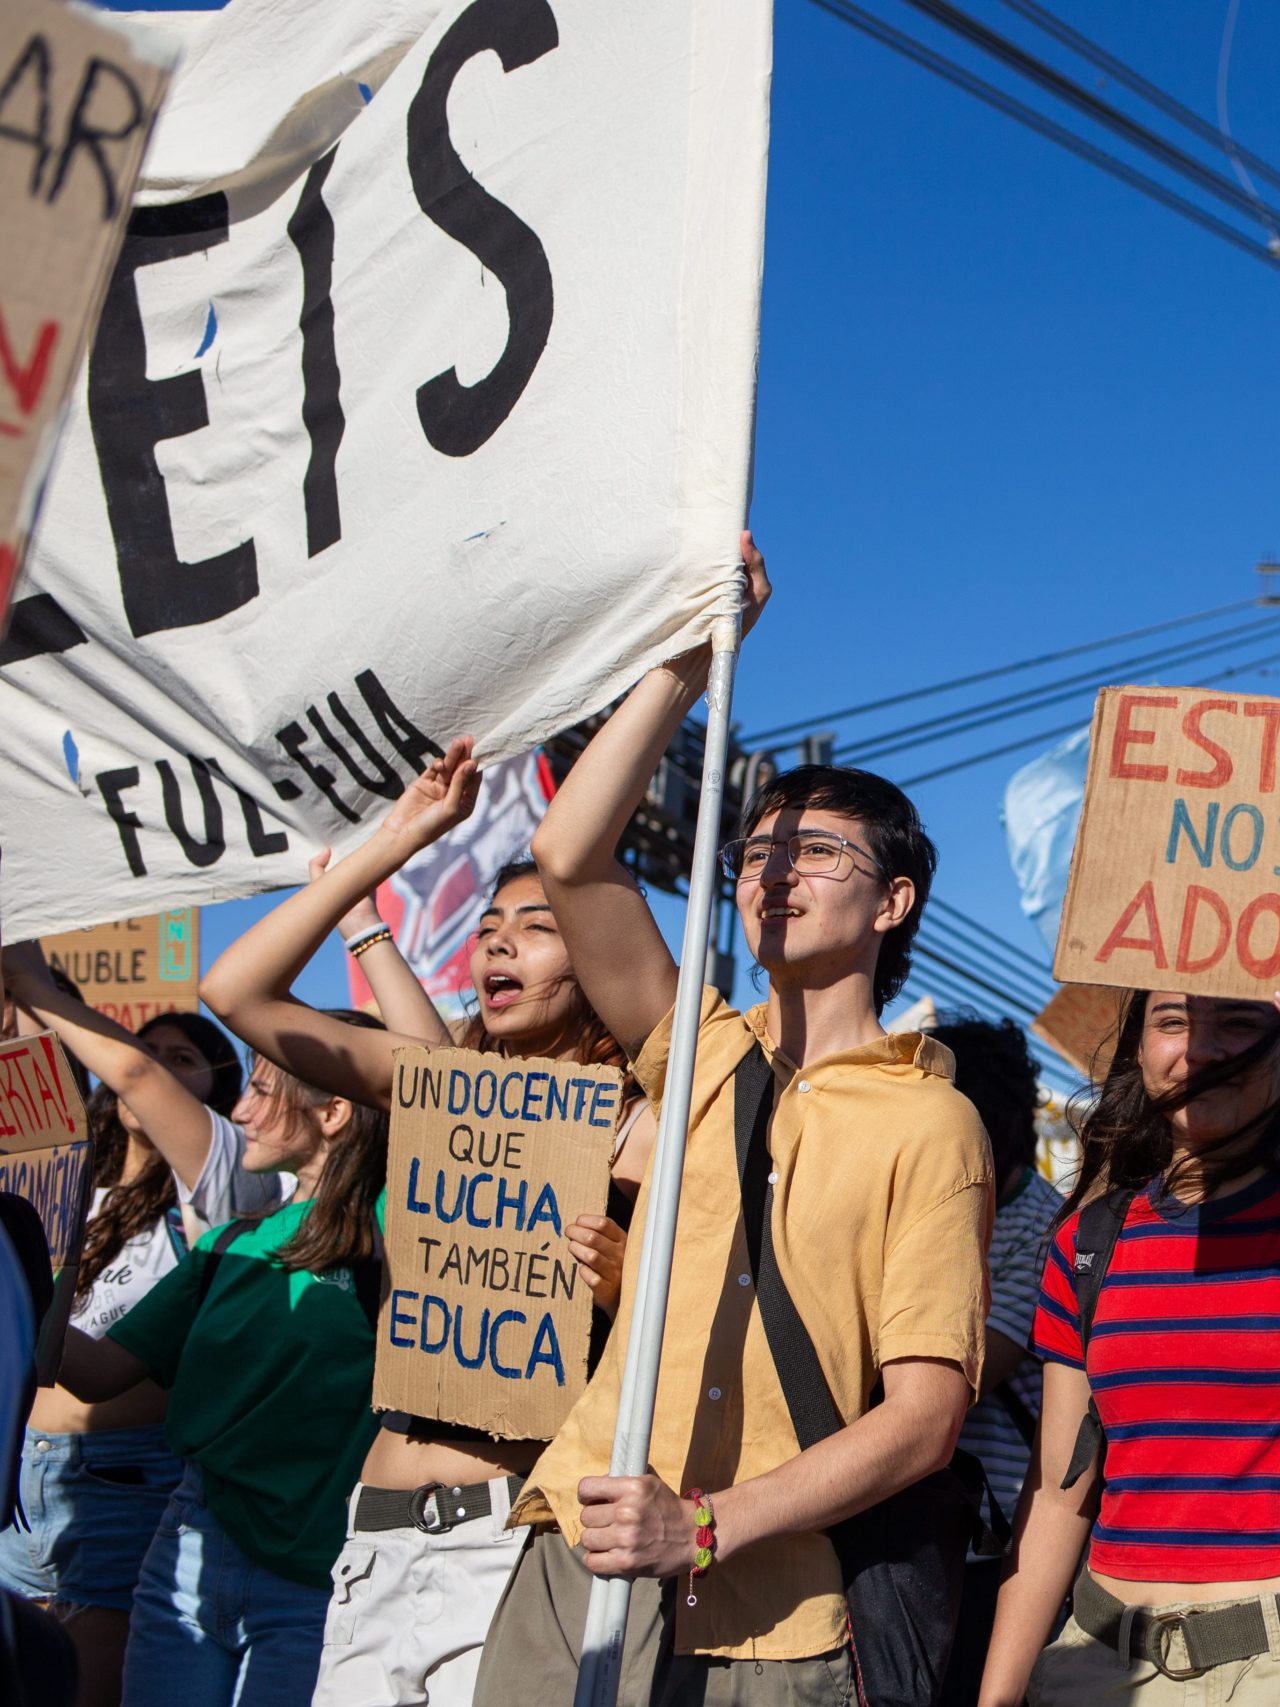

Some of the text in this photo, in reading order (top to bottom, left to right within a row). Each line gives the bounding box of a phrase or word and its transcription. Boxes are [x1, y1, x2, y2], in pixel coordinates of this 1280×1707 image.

[0, 0, 558, 668] EIS
[1165, 798, 1265, 872] NO
[399, 1063, 619, 1127] UN DOCENTE
[449, 1124, 526, 1169] QUE
[407, 1157, 562, 1239] LUCHA
[418, 1236, 578, 1300] TAMBIÉN
[390, 1289, 565, 1386] EDUCA
